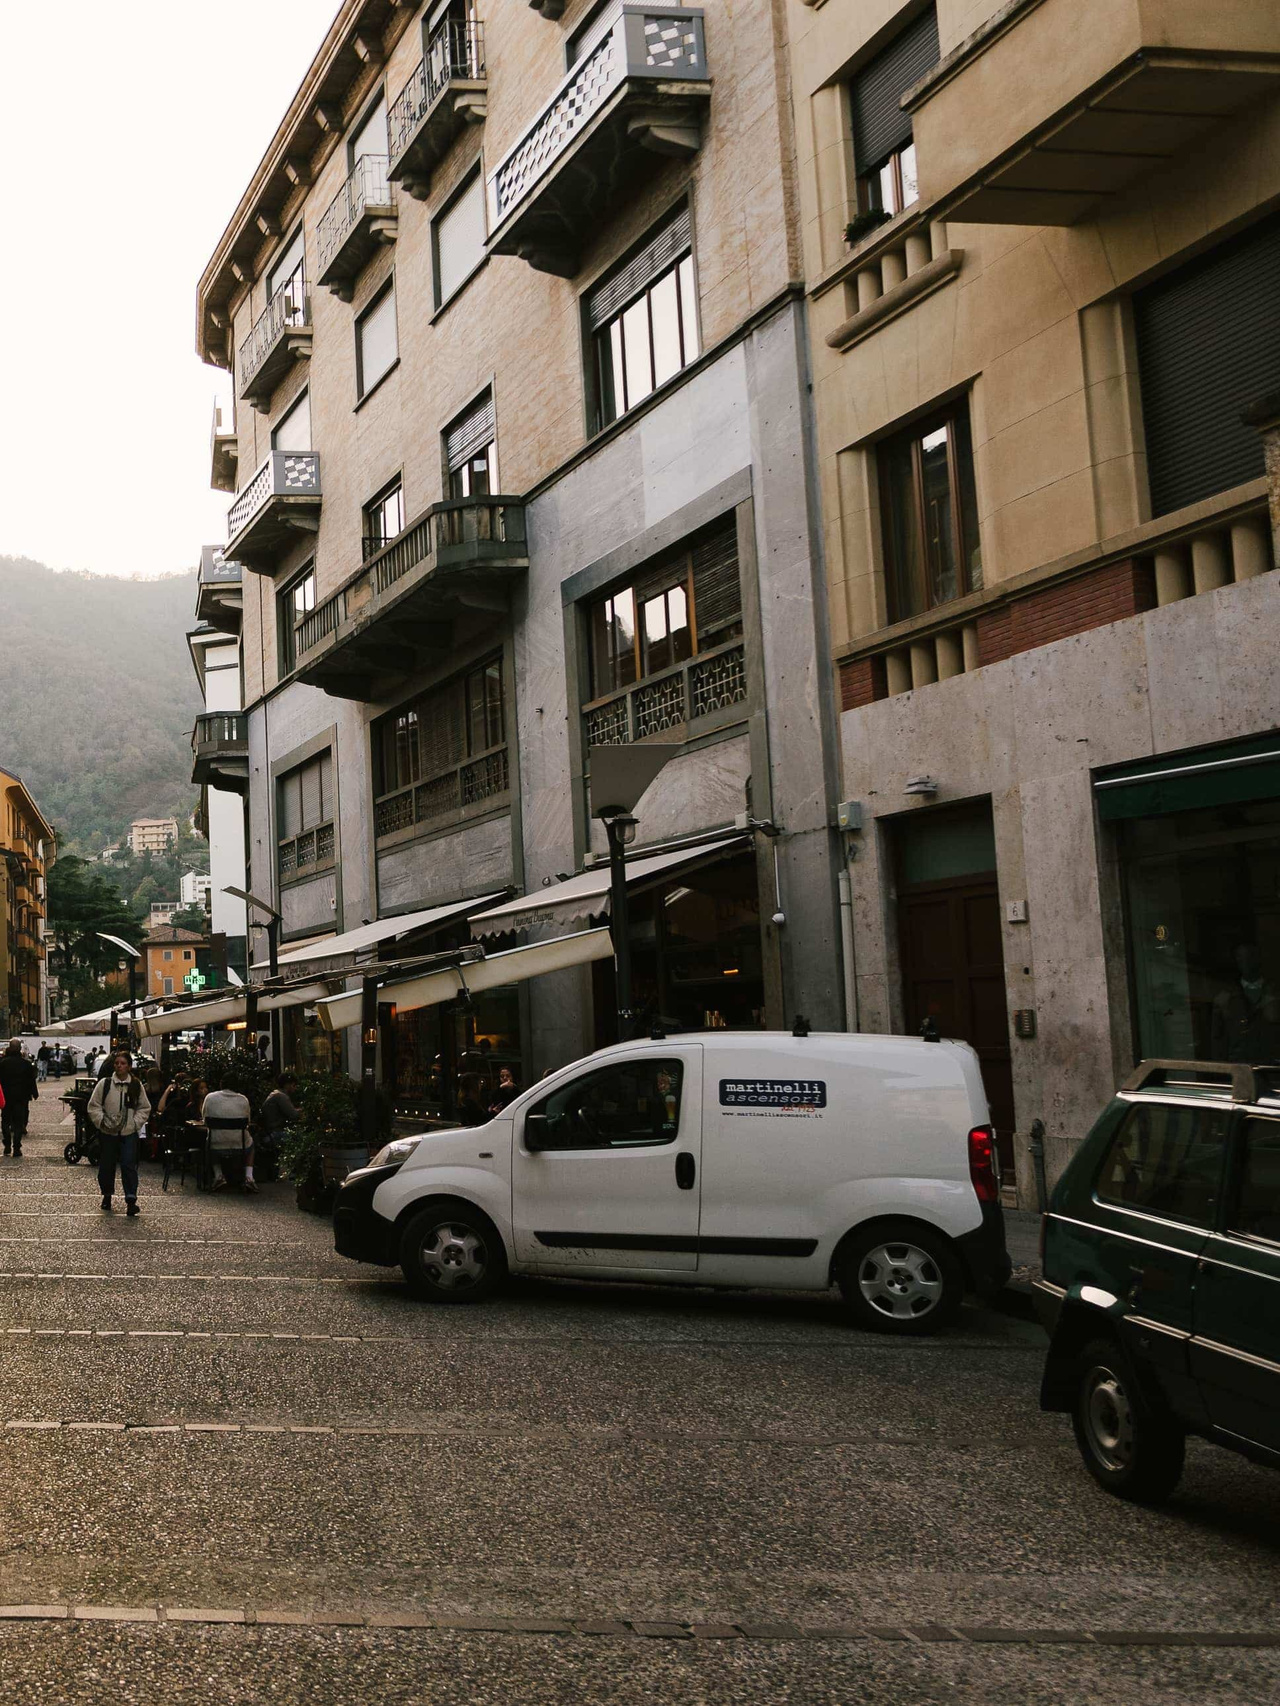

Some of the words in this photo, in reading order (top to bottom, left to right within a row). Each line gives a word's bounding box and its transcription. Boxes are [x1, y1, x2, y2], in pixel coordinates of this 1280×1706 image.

[1012, 905, 1018, 917] 6
[725, 1082, 822, 1094] martinelli
[725, 1094, 822, 1104] ascensori
[722, 1111, 824, 1119] www.martinelliascensori.it
